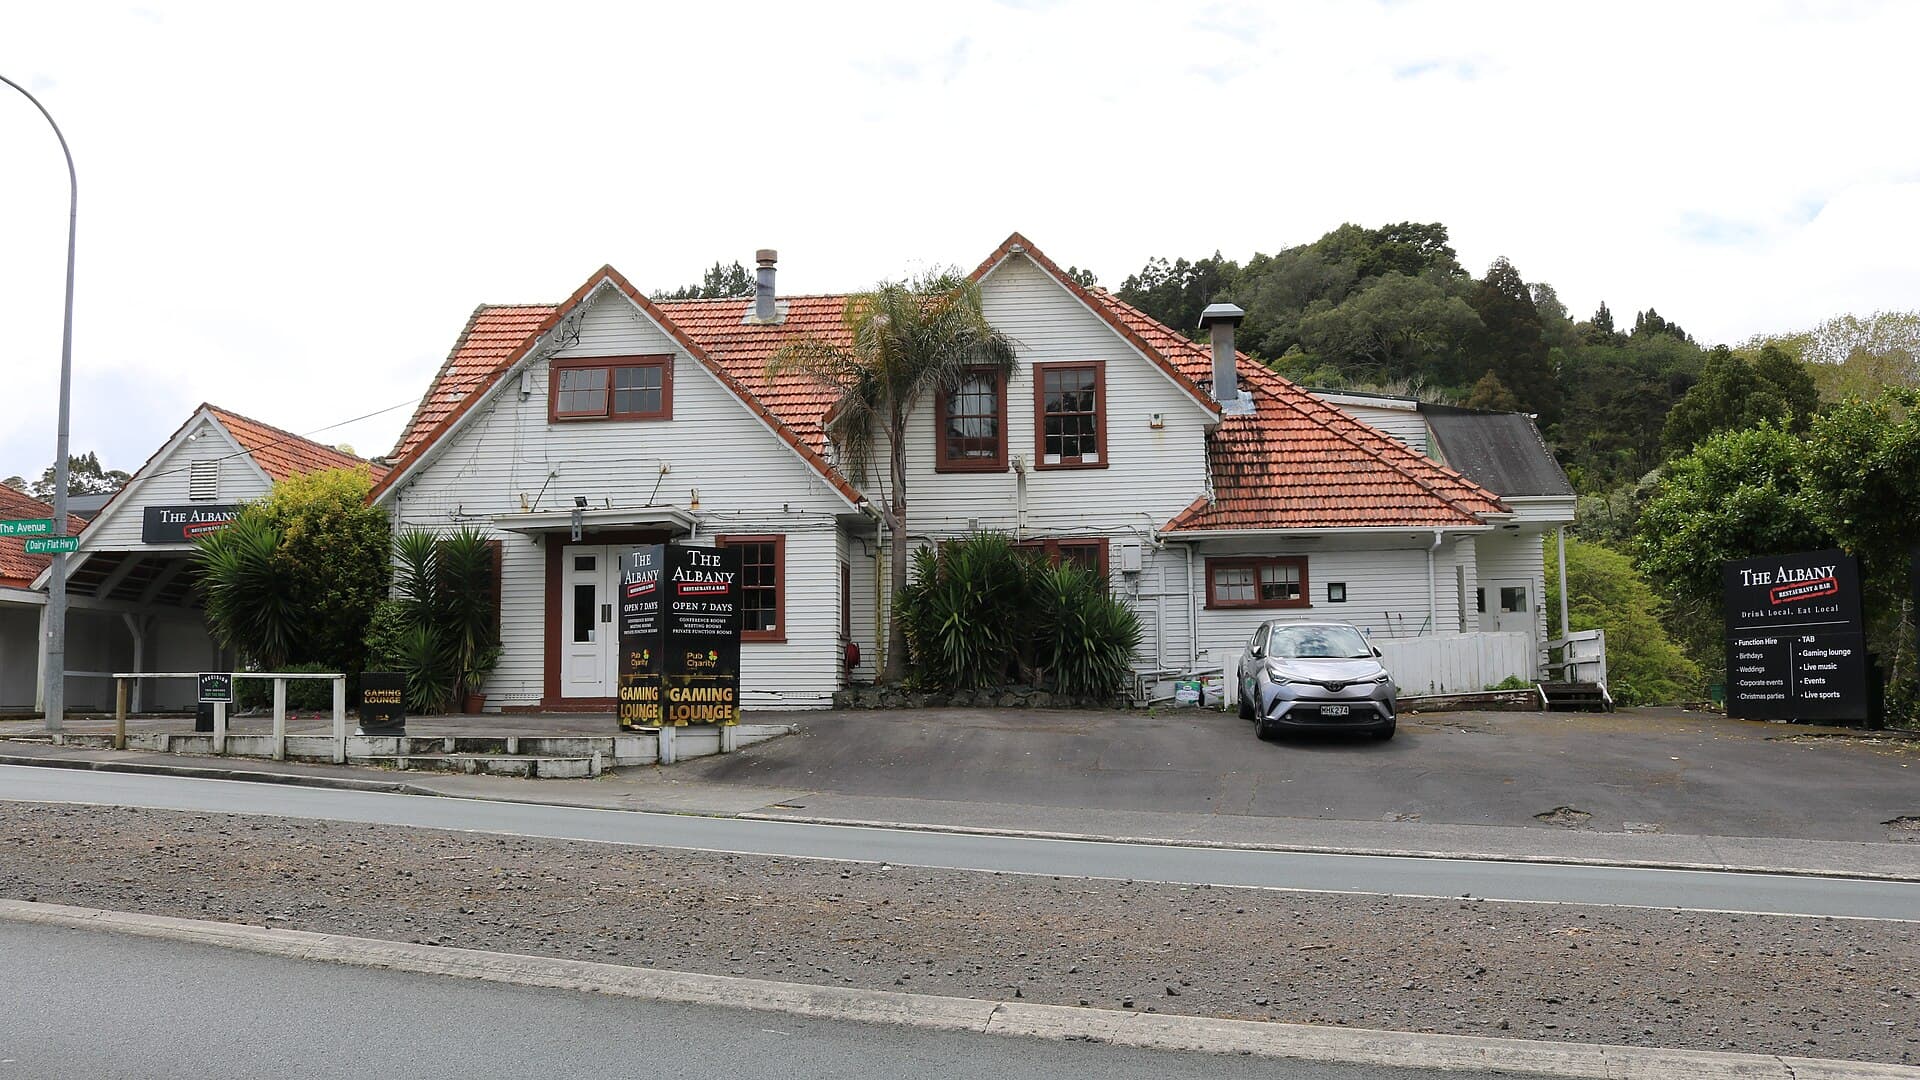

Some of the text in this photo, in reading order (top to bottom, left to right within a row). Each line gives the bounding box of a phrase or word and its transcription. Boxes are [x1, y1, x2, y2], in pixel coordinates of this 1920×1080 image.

[160, 510, 187, 523] THE
[0, 523, 46, 533] The Avenue
[30, 540, 74, 551] Dairy Flat Hwy
[632, 552, 652, 567] THE
[687, 550, 721, 567] THE
[624, 569, 659, 585] ALBANY
[672, 566, 735, 584] ALBANY
[1740, 565, 1836, 586] THE ALBANY
[1818, 582, 1831, 590] BAR
[624, 603, 639, 612] OPEN
[644, 601, 658, 610] DAYS
[672, 601, 733, 612] OPEN 7 DAYS
[1741, 603, 1839, 618] Drink Local. Eat Local
[1764, 637, 1778, 645] Hire
[1801, 635, 1816, 643] TAB
[1739, 652, 1764, 660] Birthdays
[1802, 648, 1851, 658] Gaming lounge
[686, 660, 716, 668] Charity
[1803, 662, 1838, 671] Live music
[1739, 666, 1766, 674] Weddings
[1804, 677, 1826, 685] Events
[364, 689, 401, 697] GAMING
[621, 686, 659, 701] GAMING
[669, 687, 733, 702] GAMING
[1740, 692, 1785, 701] Christmas parties
[1804, 690, 1841, 699] Live sports
[620, 703, 658, 719] LOUNGE
[669, 704, 733, 720] LOUNGE
